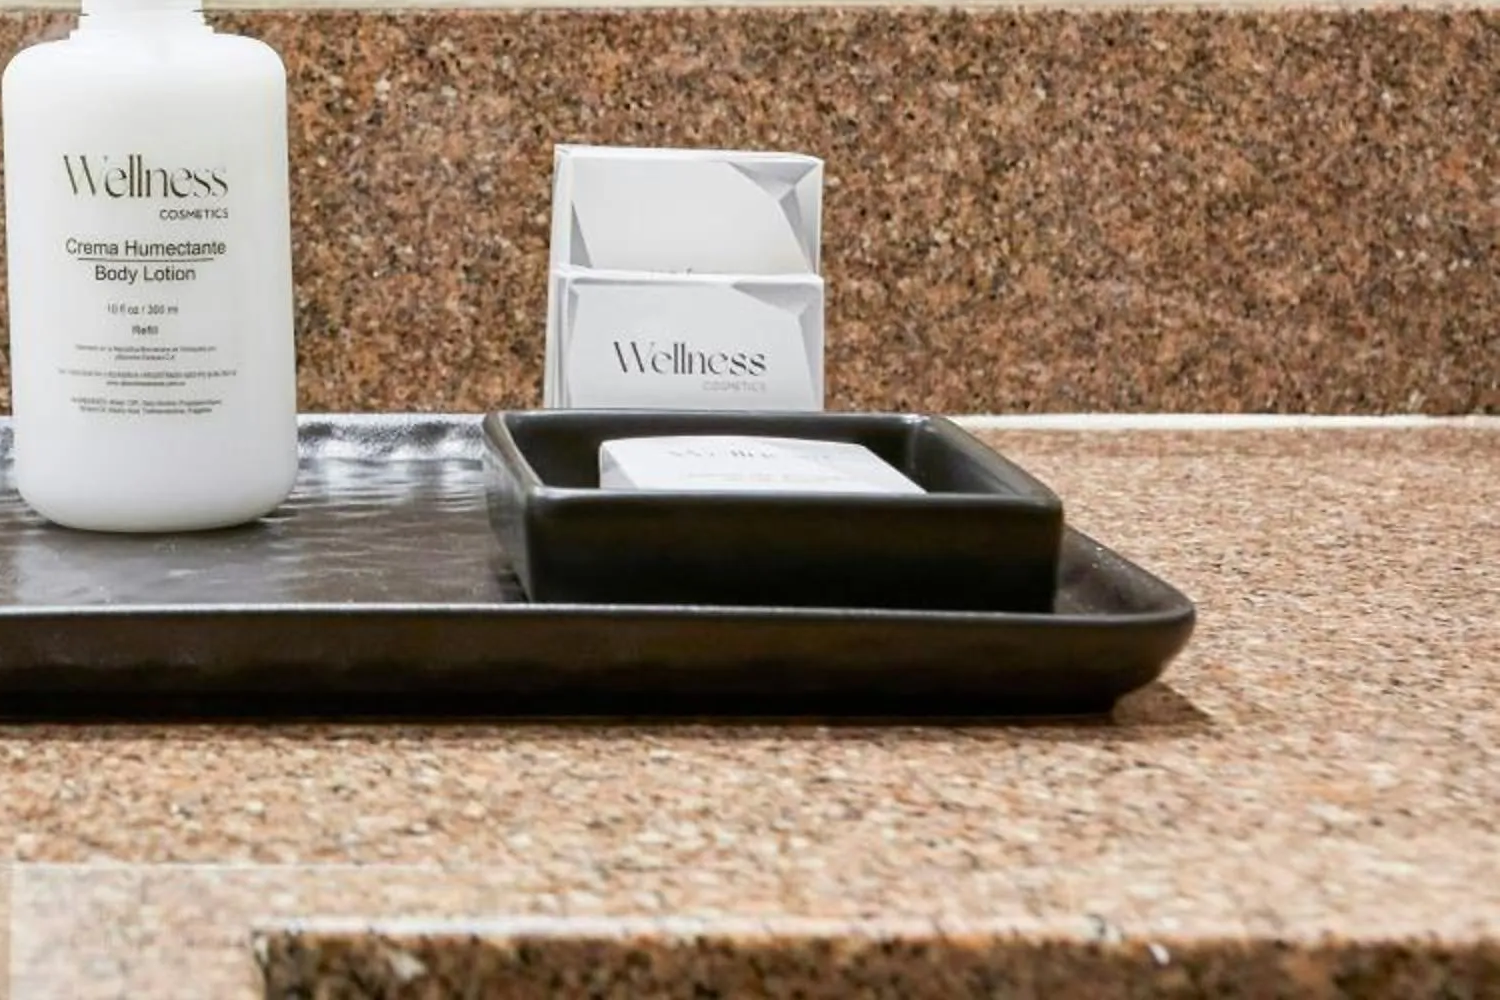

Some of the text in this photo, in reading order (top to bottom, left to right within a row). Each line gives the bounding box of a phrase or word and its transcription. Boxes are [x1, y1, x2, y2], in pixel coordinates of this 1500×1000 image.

[63, 154, 229, 198] Wellness
[159, 207, 229, 220] COSMETICS
[65, 238, 227, 256] Crema Humectante
[95, 265, 196, 285] Body Lotion
[131, 325, 159, 336] Refill
[613, 341, 767, 377] Wellness
